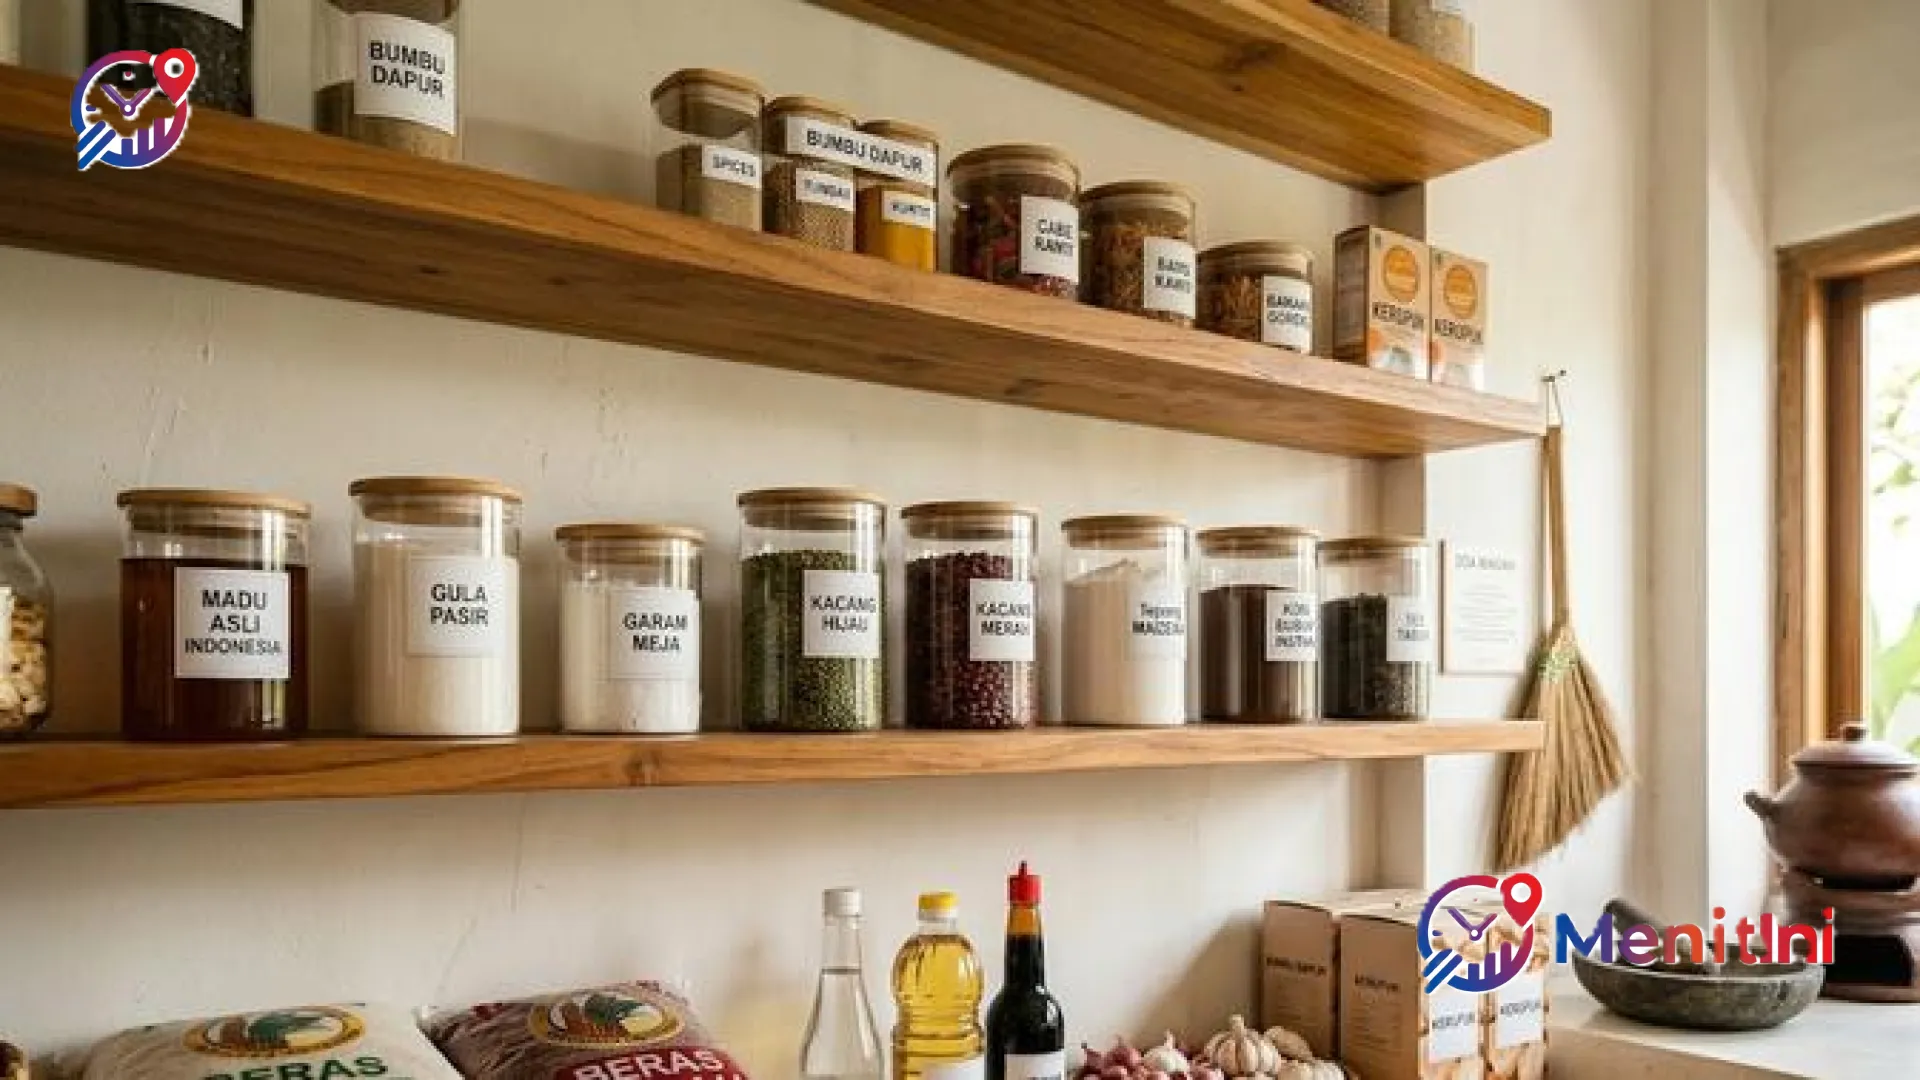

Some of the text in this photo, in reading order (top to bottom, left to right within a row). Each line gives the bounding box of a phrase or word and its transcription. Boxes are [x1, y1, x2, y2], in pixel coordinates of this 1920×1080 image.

[368, 41, 446, 75] BUMBU
[371, 65, 445, 98] DAPUR
[806, 128, 923, 174] BUMBU DAPUR
[202, 588, 267, 610] MADU
[430, 584, 487, 603] GULA
[809, 595, 877, 614] KACANG
[209, 614, 260, 634] ASLI
[430, 606, 489, 627] PASIR
[622, 612, 688, 632] GARAM
[821, 615, 868, 634] HIJAU
[185, 637, 281, 656] INDONESIA
[633, 634, 680, 653] MEJA
